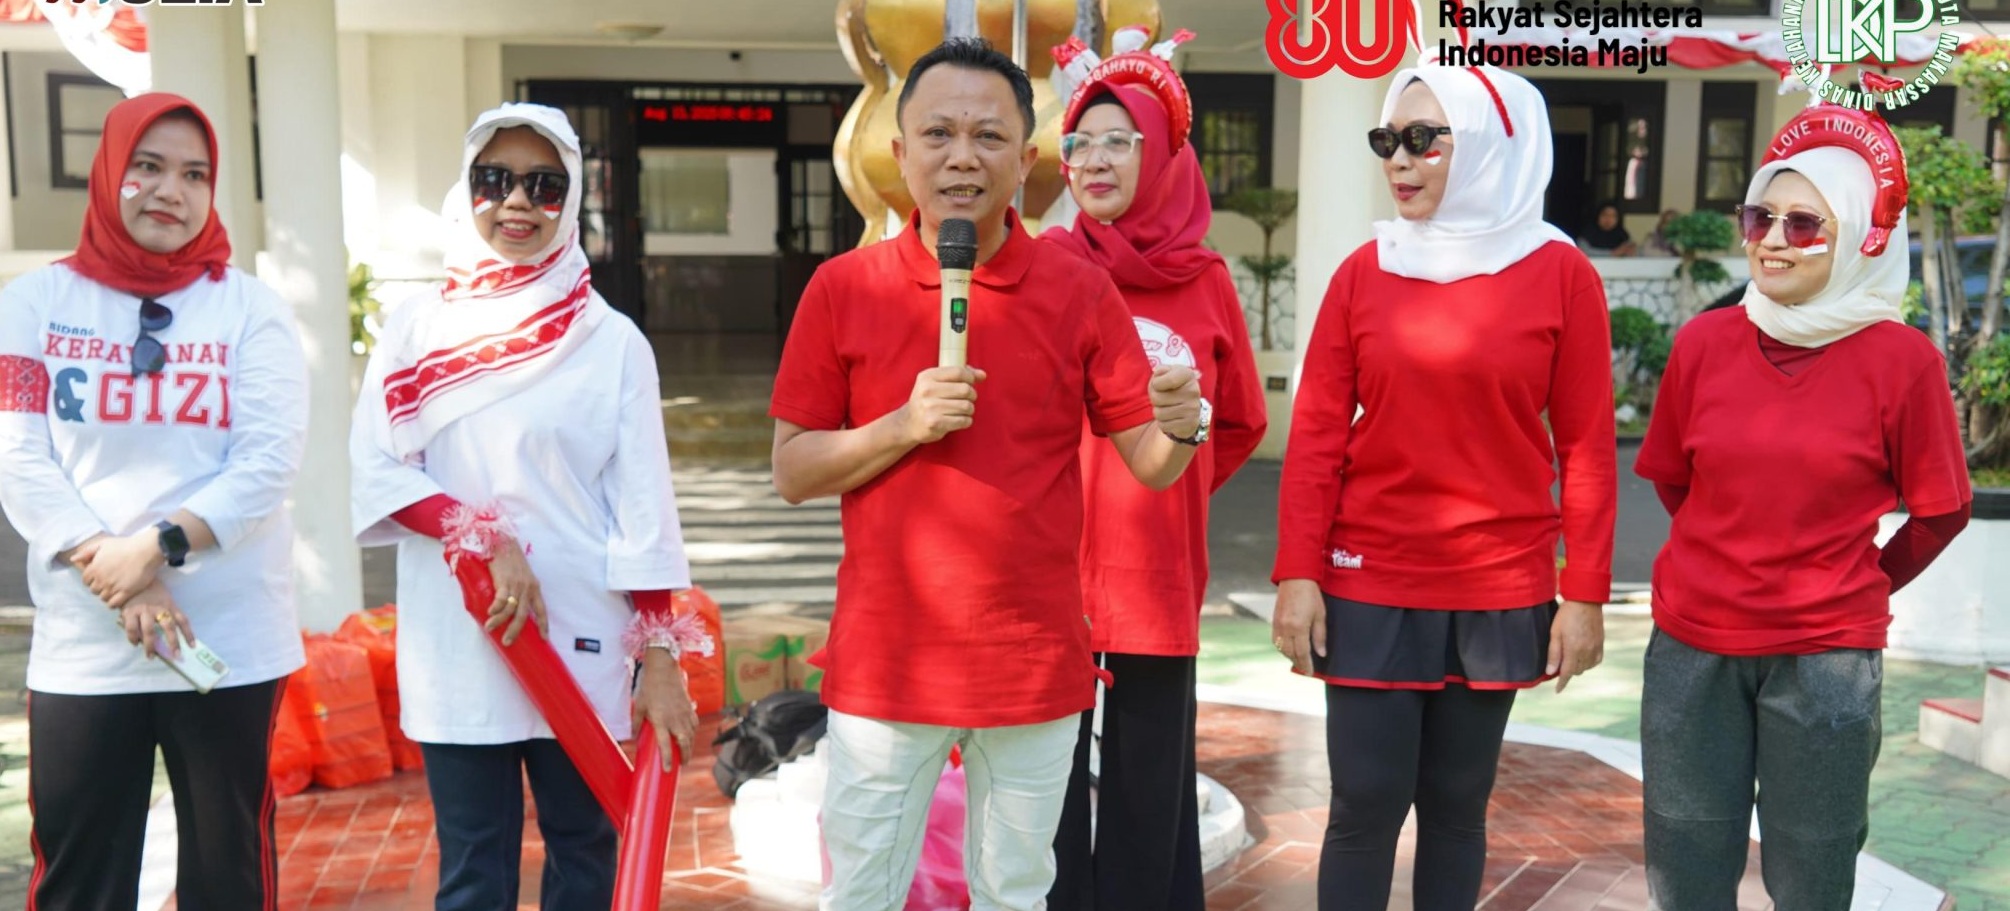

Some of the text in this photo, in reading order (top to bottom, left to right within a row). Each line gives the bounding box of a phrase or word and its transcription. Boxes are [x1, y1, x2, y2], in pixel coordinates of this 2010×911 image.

[1772, 117, 1895, 190] LOVE INDONESIA
[54, 367, 232, 430] & GIZI
